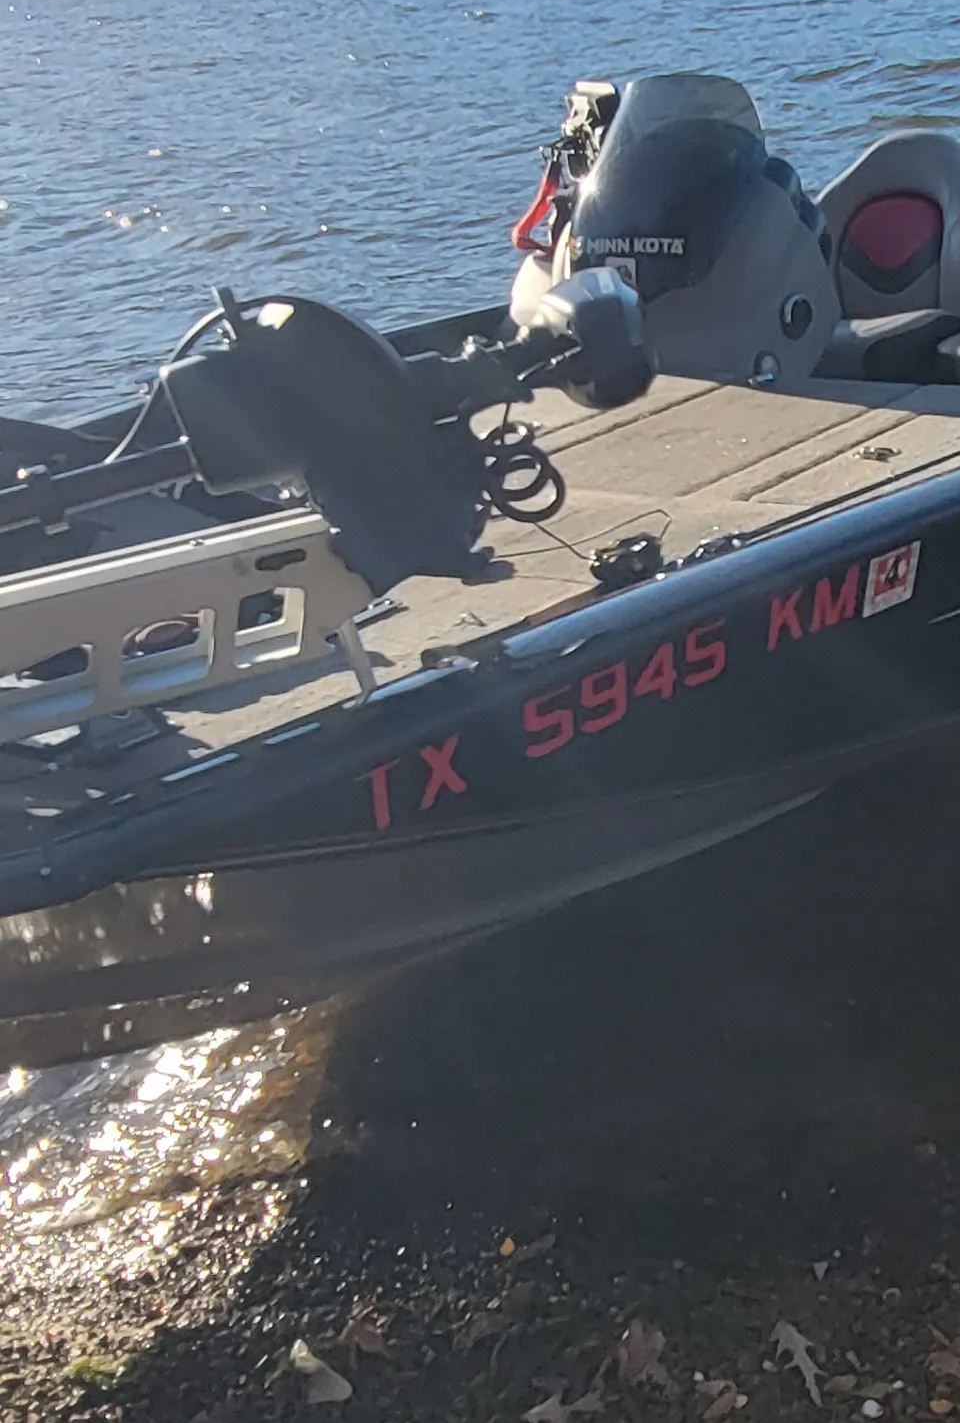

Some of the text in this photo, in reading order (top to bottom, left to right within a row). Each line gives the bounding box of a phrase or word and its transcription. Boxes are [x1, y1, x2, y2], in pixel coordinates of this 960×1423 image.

[586, 237, 686, 255] MINN KOTA
[353, 564, 861, 830] TX 5945 KM
